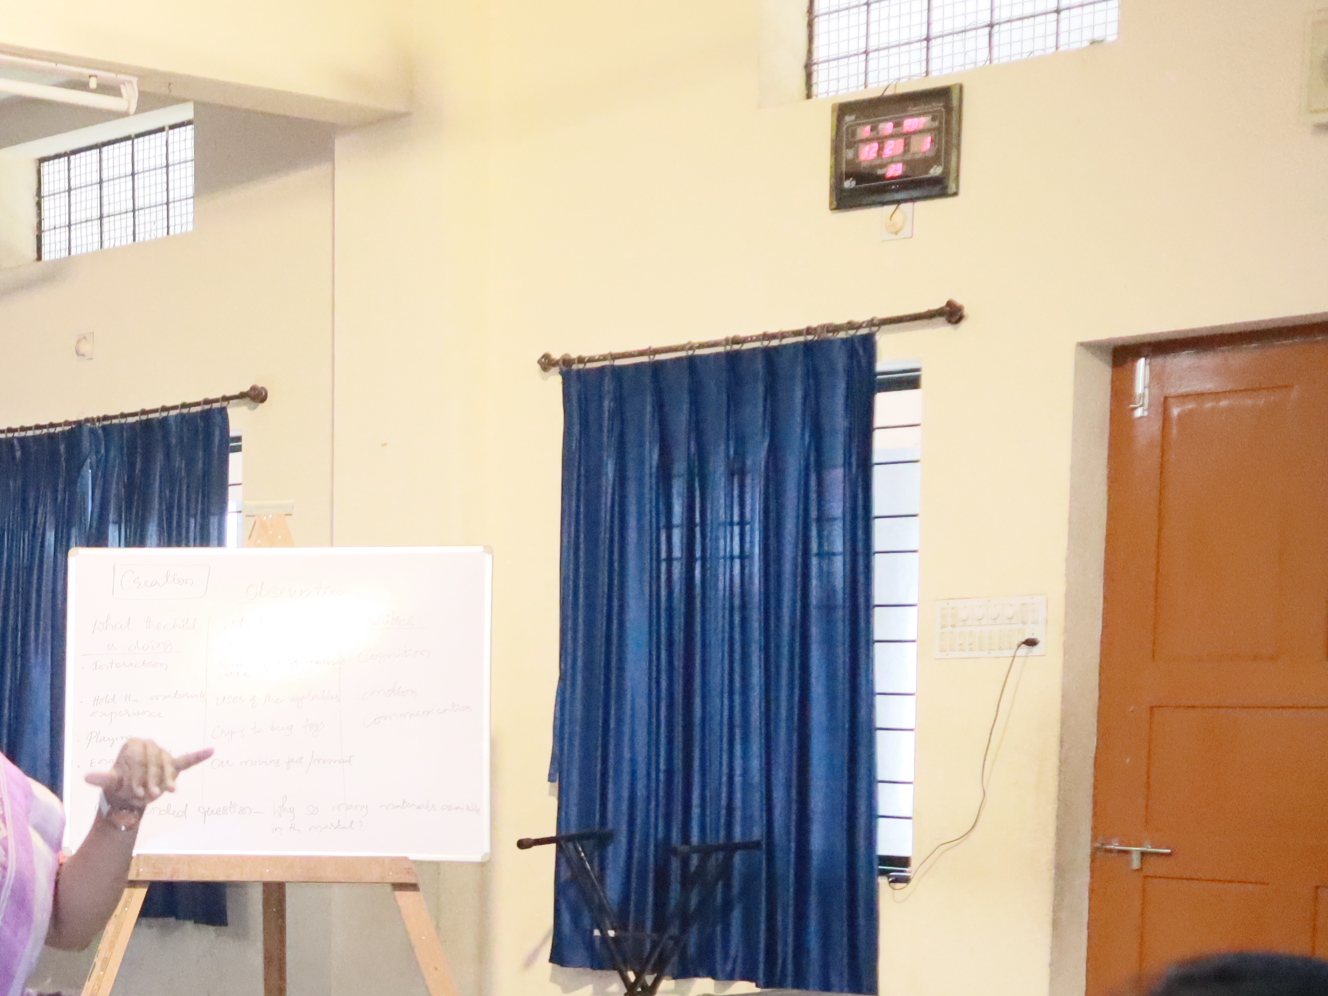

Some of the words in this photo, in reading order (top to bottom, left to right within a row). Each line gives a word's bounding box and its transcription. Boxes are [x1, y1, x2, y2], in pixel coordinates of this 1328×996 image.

[120, 569, 195, 592] Creation
[91, 613, 133, 635] What
[128, 638, 174, 654] doing
[357, 645, 431, 664] Cognition
[92, 693, 118, 707] Hold
